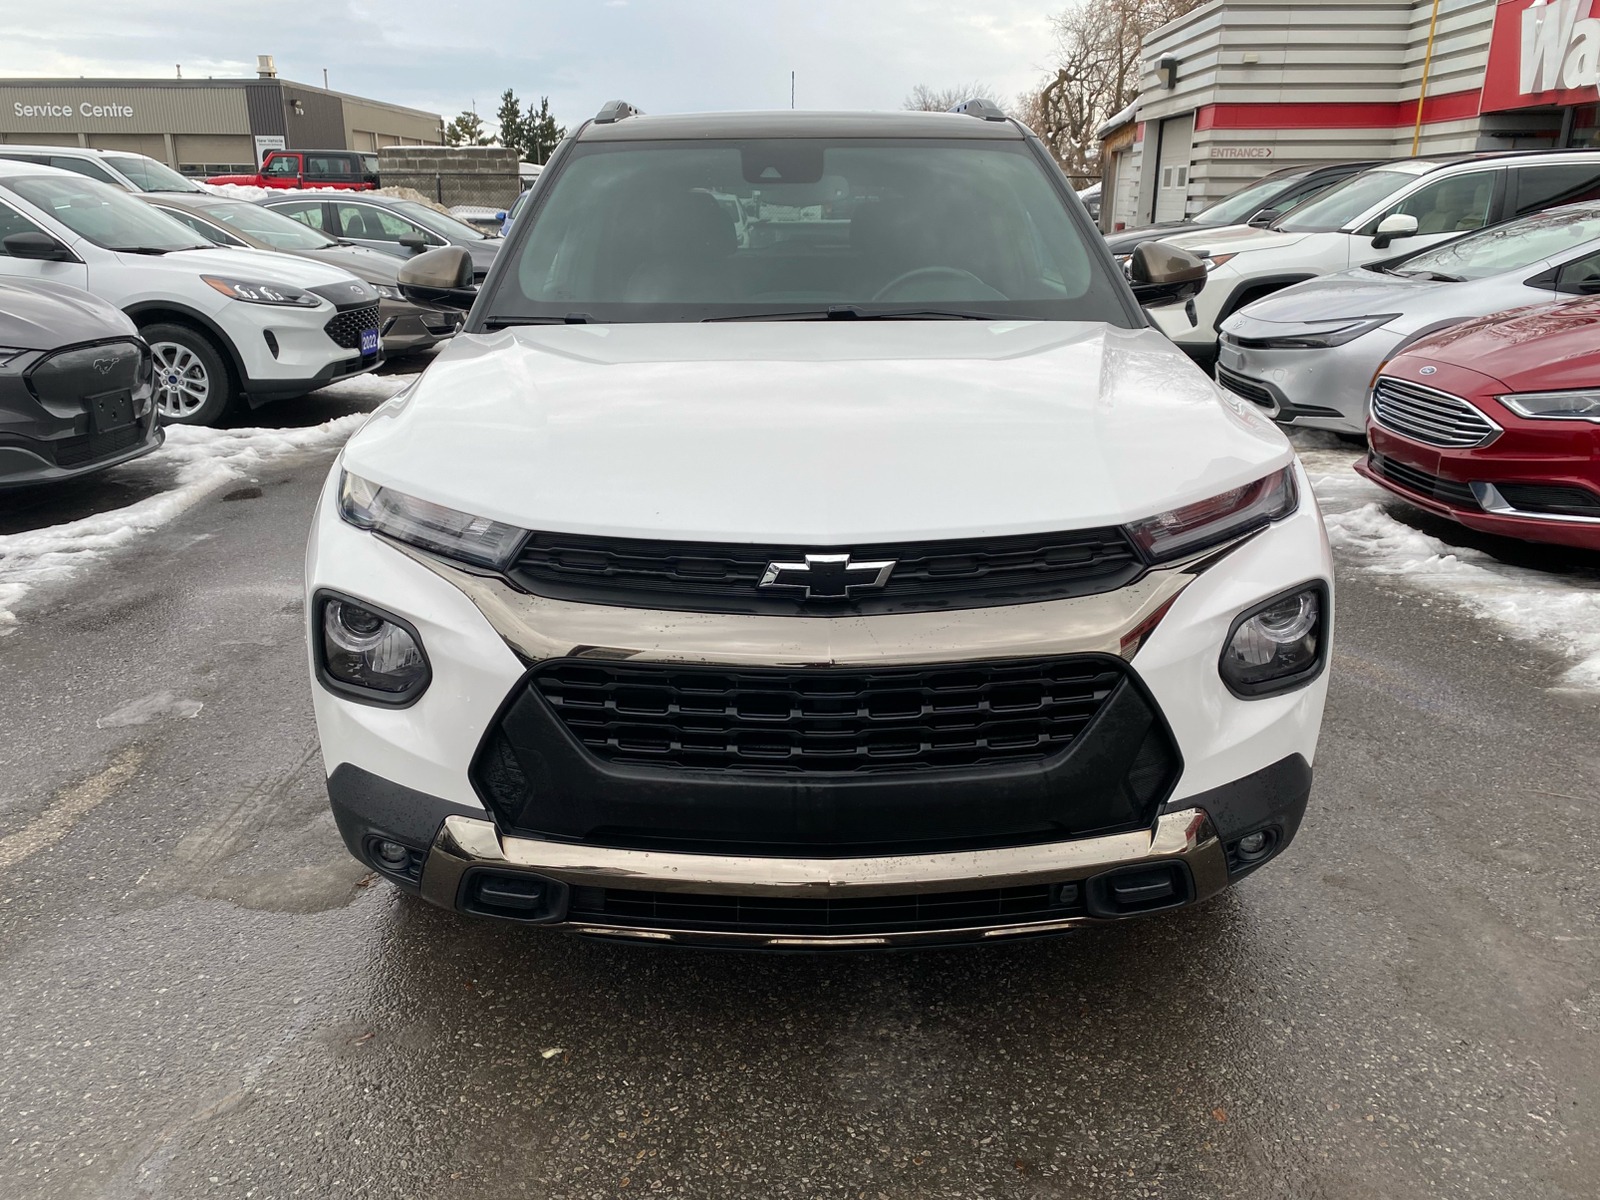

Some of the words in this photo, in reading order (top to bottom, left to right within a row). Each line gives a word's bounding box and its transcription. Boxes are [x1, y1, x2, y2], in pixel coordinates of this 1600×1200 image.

[1519, 0, 1600, 98] Wa
[14, 102, 73, 117] Service
[80, 102, 133, 117] Centre
[1210, 148, 1264, 157] ENTRANCE
[362, 333, 377, 350] 2022
